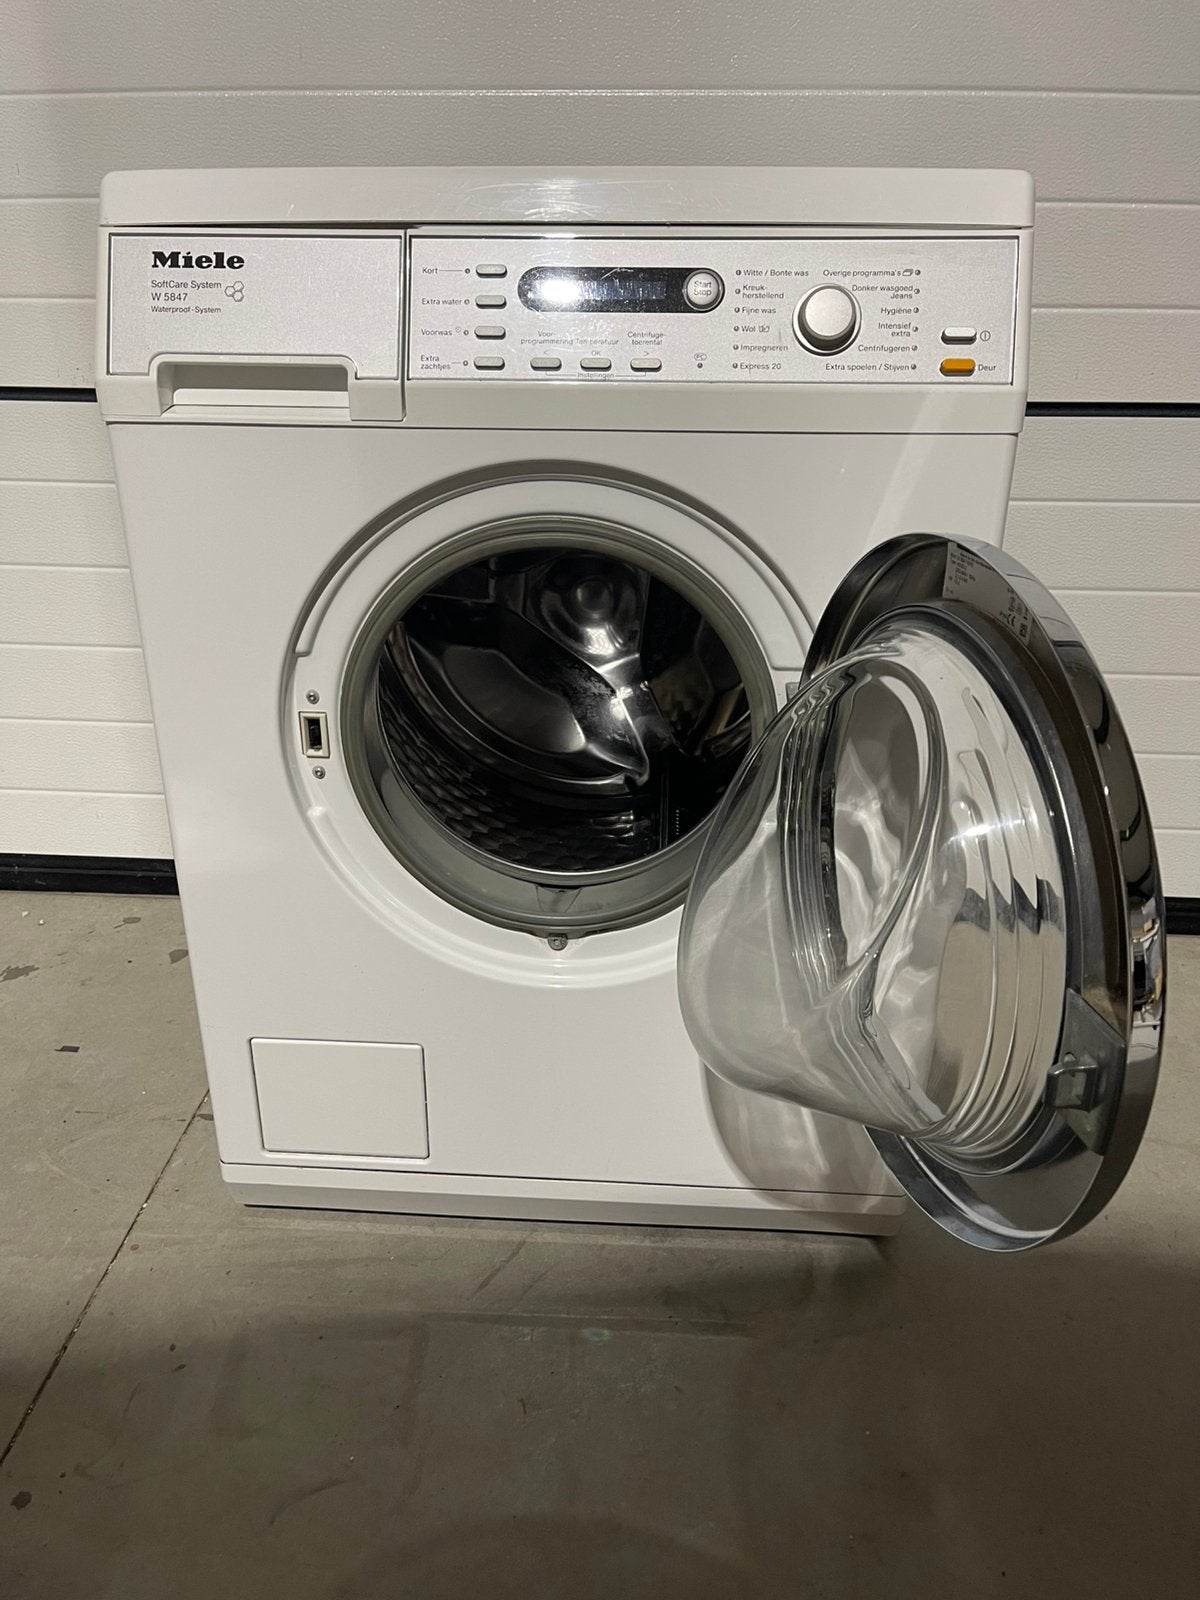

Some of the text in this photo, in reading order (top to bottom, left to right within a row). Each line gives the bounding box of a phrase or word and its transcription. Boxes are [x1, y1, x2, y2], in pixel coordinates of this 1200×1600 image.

[152, 251, 245, 270] Miele
[151, 280, 222, 290] SoftCare System
[694, 288, 712, 297] Stop
[740, 344, 788, 352] Impregneren
[884, 364, 910, 372] Stijven
